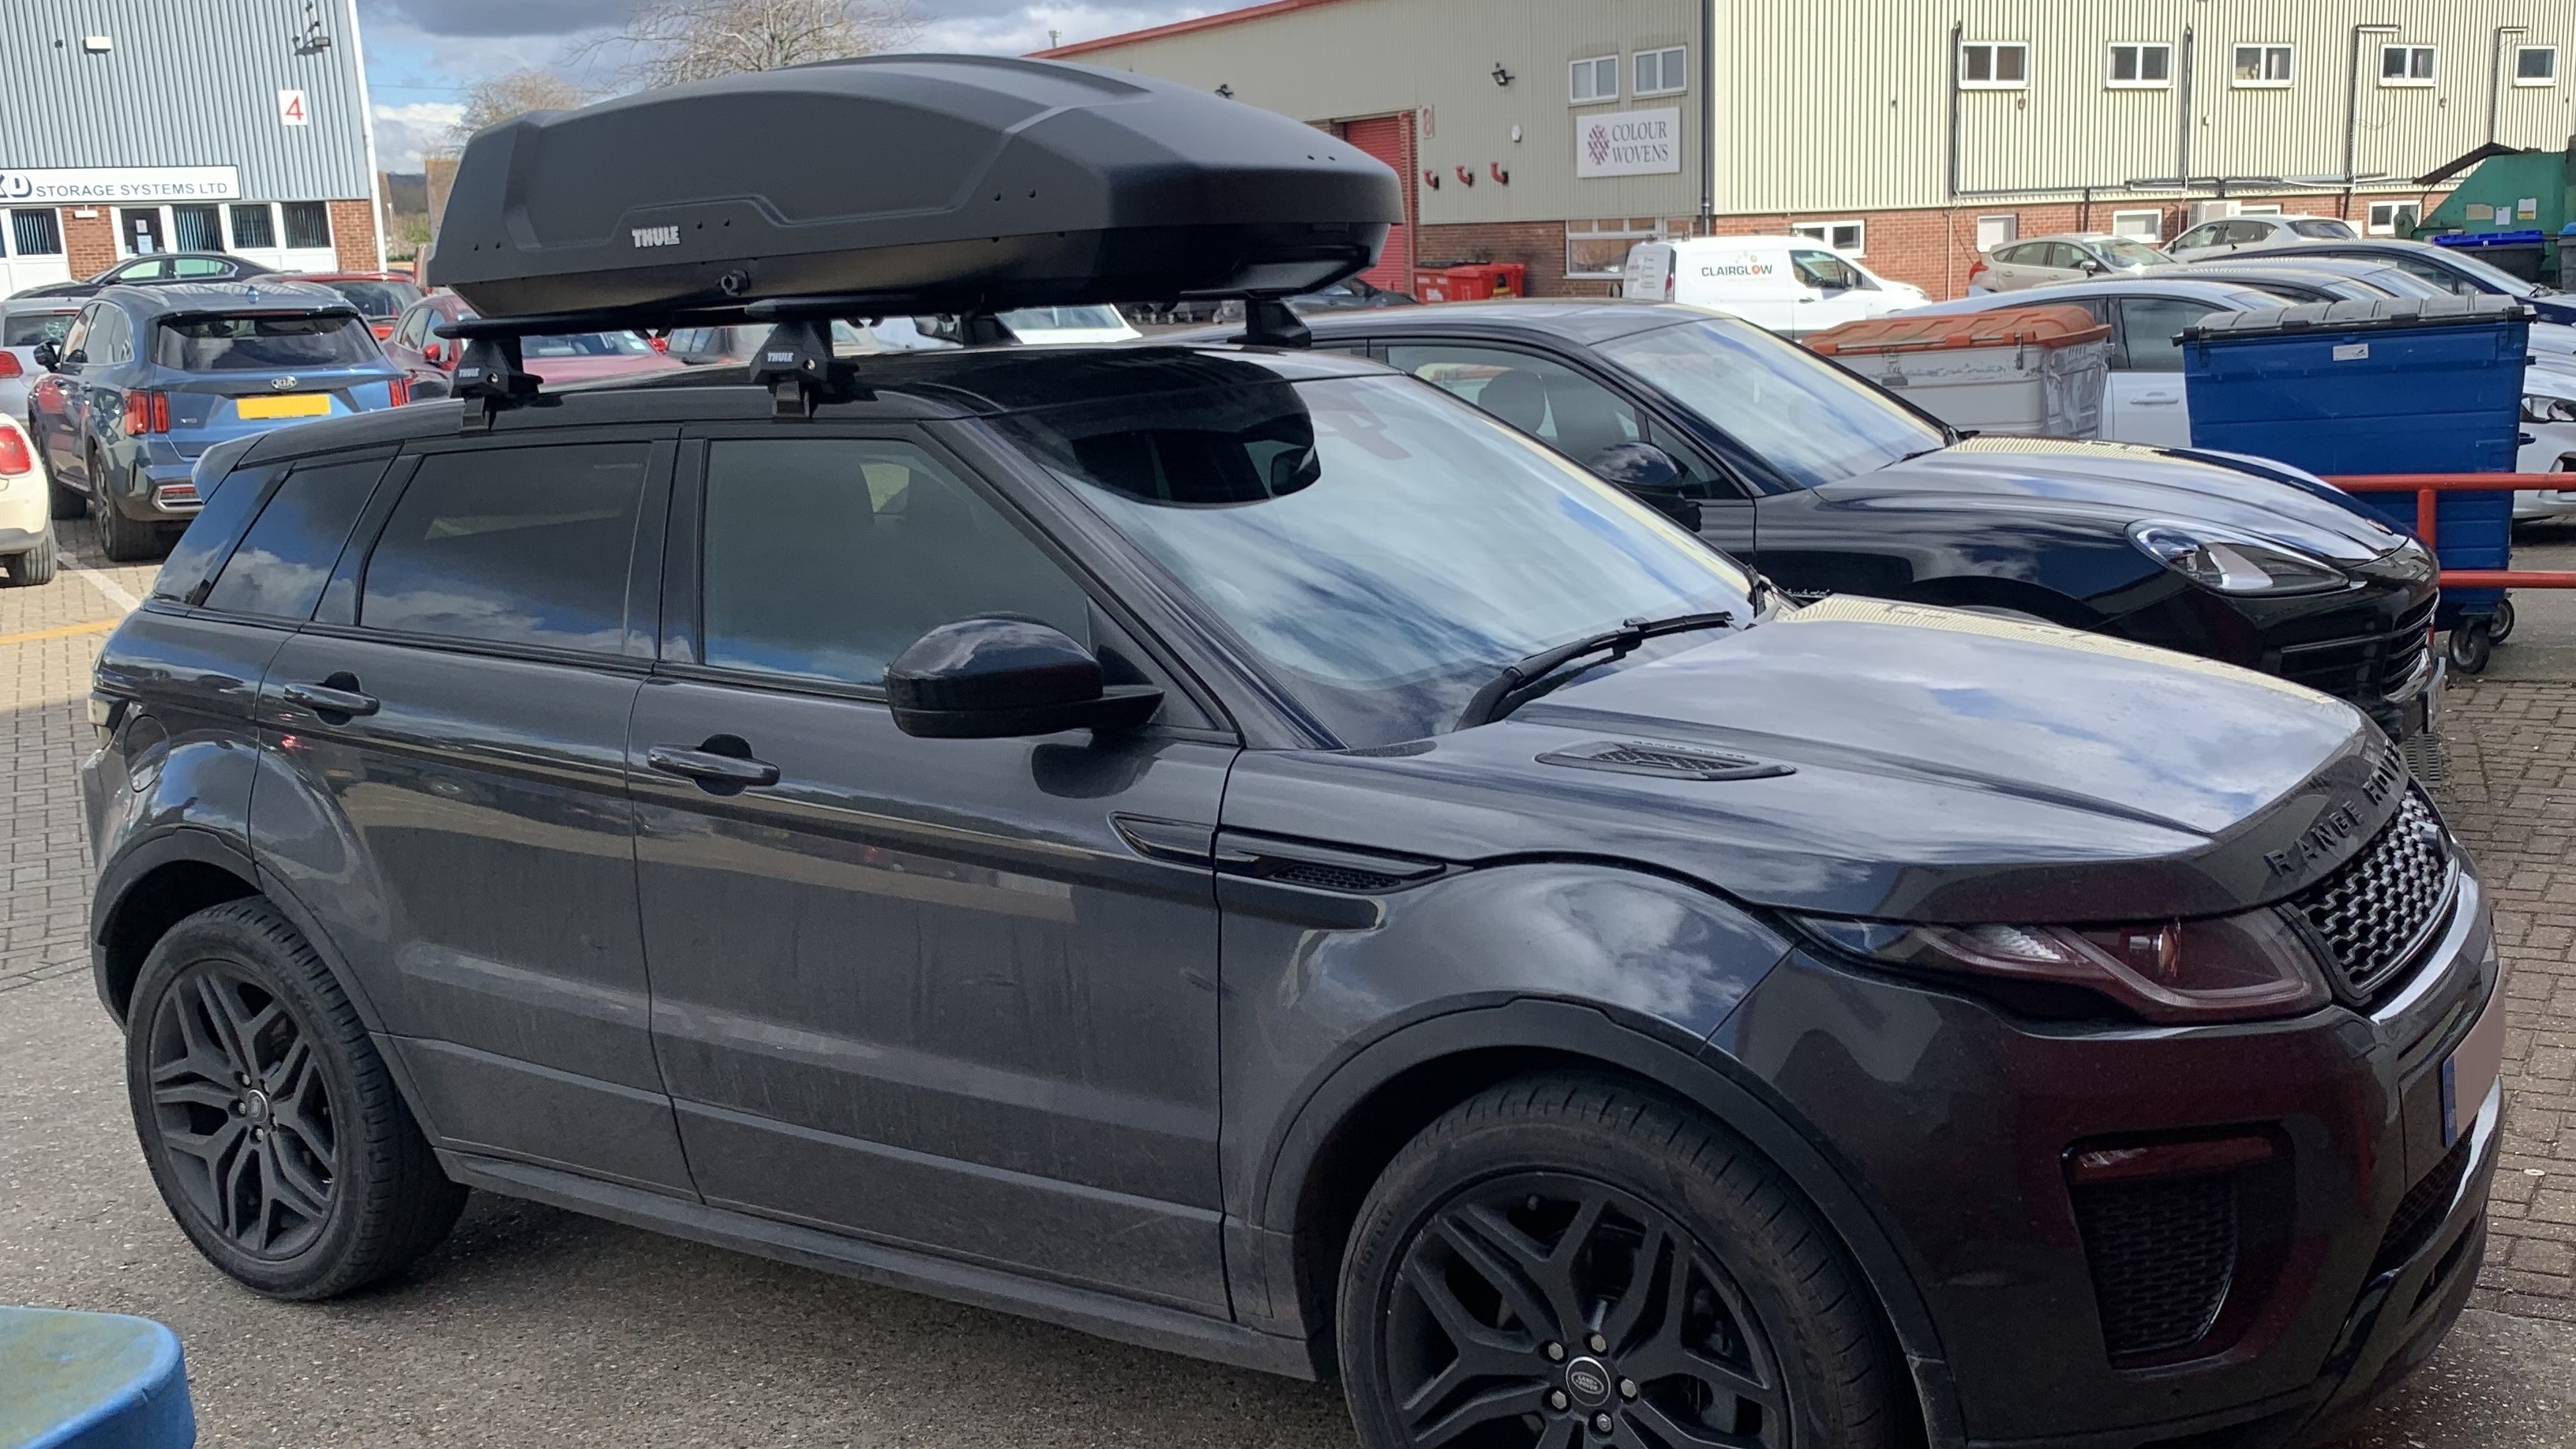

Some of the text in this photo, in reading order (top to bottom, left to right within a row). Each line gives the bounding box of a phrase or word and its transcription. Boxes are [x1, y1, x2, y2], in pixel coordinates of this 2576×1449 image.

[285, 96, 304, 121] 4
[1423, 108, 1431, 137] 8
[1612, 121, 1667, 141] COLOUR
[1612, 144, 1668, 163] WOVENS
[36, 185, 115, 197] STORAGE
[120, 183, 195, 195] SYSTEMS
[200, 183, 227, 193] LTD
[632, 226, 680, 247] THULE
[1701, 265, 1772, 276] CLAIRGLOW
[768, 352, 793, 362] THULE
[459, 368, 479, 377] THULE
[276, 378, 294, 387] KIA
[2263, 800, 2364, 878] RANGE
